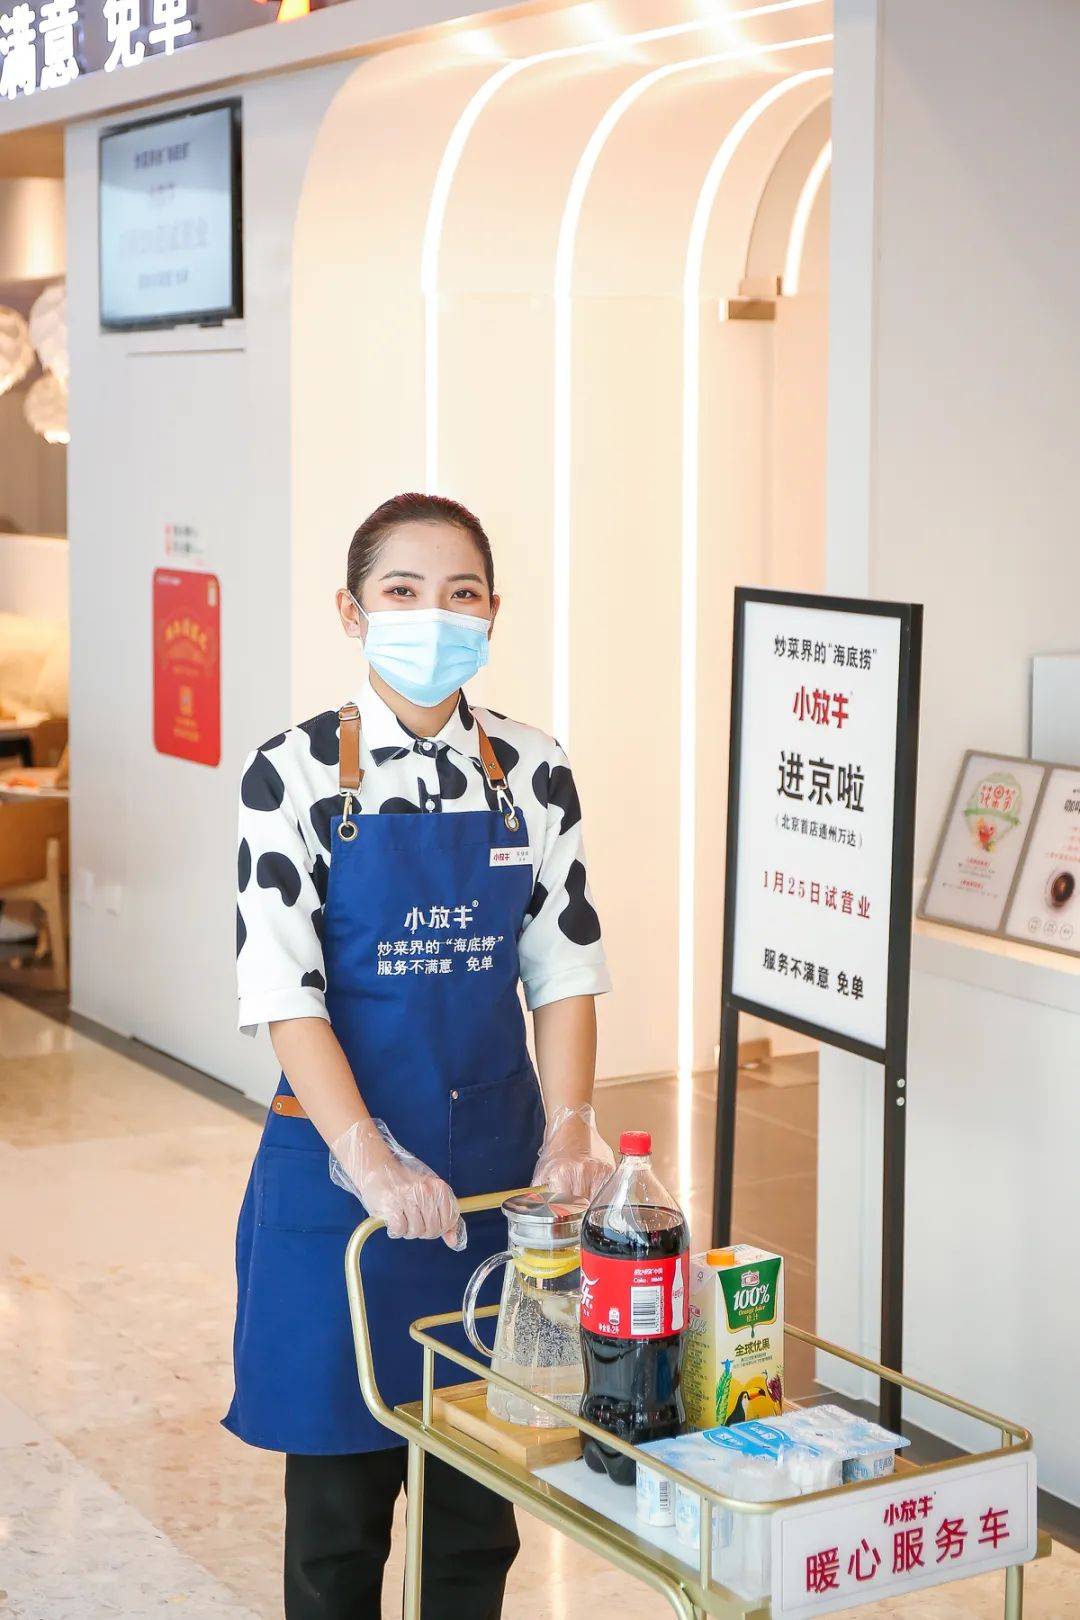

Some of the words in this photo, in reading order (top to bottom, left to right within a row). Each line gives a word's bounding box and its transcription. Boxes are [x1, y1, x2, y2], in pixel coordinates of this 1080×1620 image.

[792, 685, 850, 729] 小放牛
[777, 750, 865, 812] 进京啦
[763, 870, 871, 919] 1月25日试营业
[404, 905, 473, 934] 小放牛
[377, 958, 453, 976] 服务不满意
[466, 955, 494, 972] 免单
[762, 947, 830, 990] 服务不满意
[836, 970, 865, 1001] 免单
[733, 1283, 770, 1311] 100%
[735, 1338, 770, 1356] 全球优果
[883, 1495, 934, 1527] 小放牛
[804, 1507, 1010, 1594] 暖心服务车
